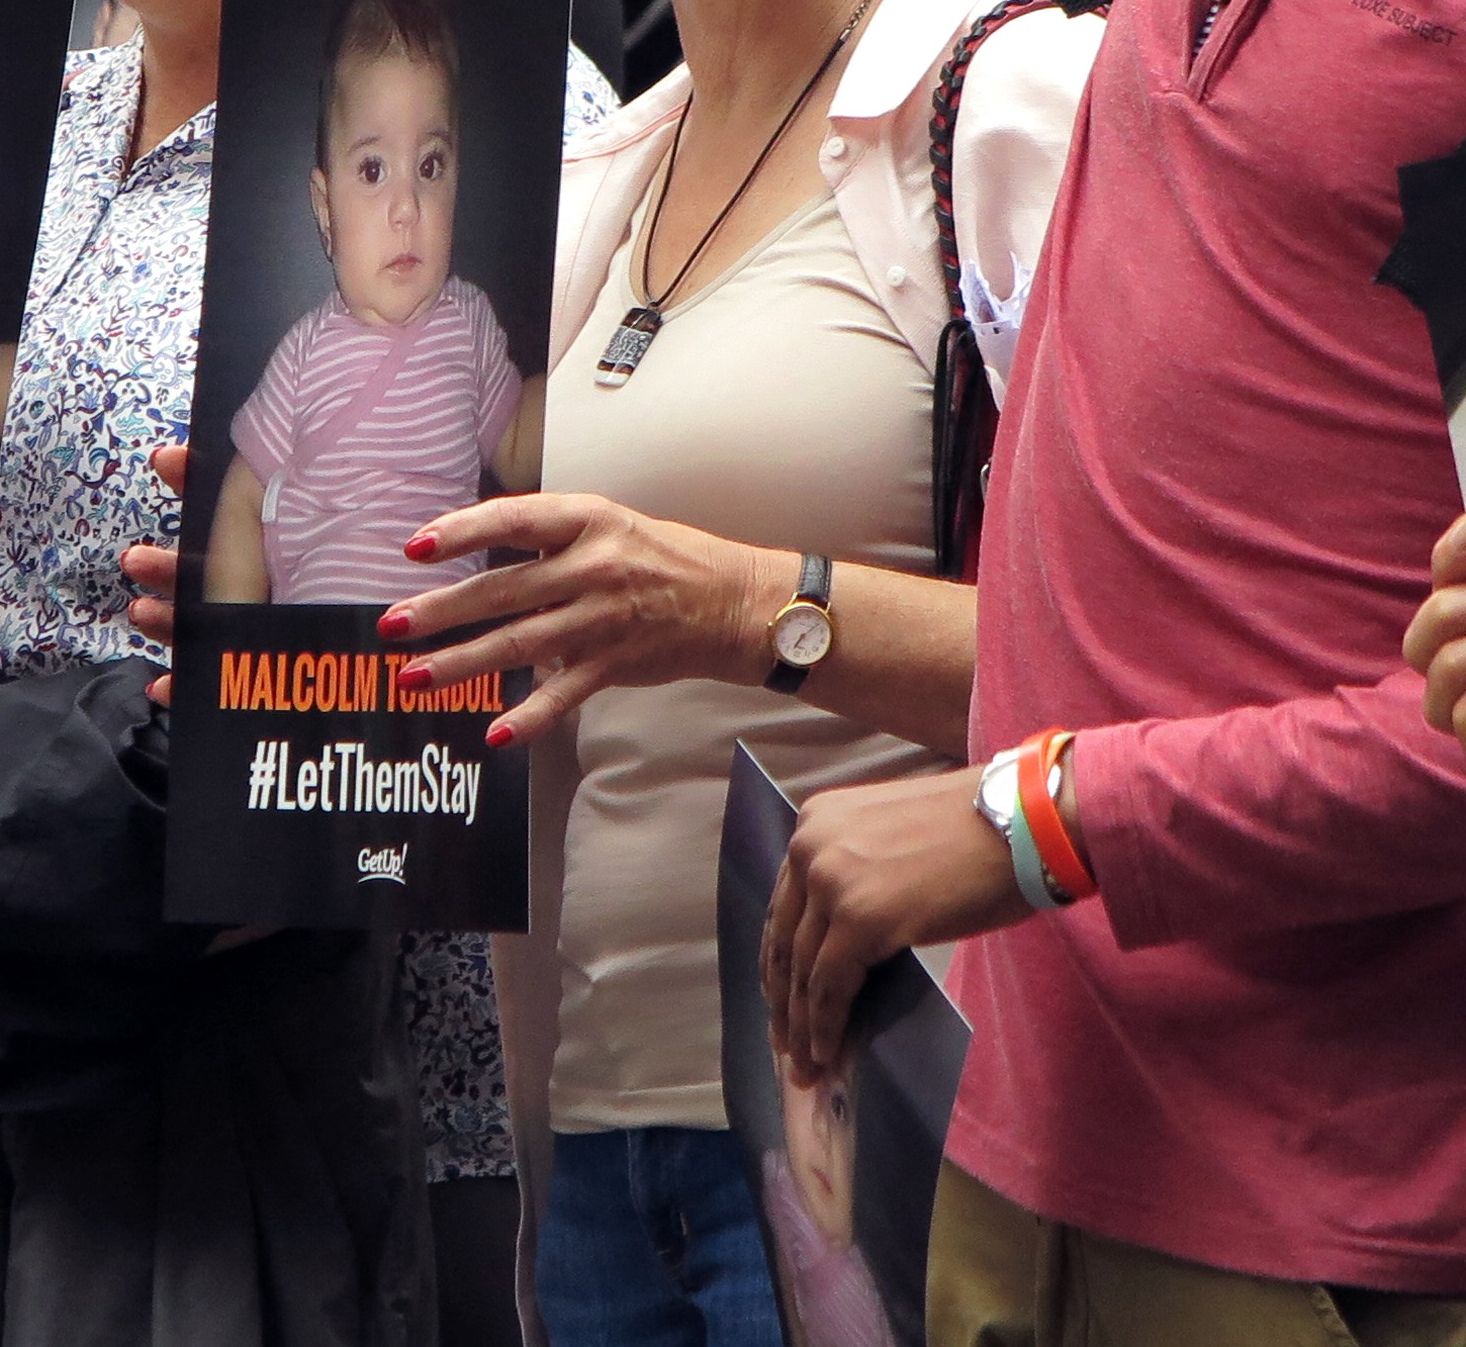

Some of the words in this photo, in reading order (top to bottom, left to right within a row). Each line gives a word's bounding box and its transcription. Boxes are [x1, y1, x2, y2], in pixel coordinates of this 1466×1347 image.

[219, 651, 378, 712] MALCOLM
[247, 739, 481, 826] #LetThemStay
[358, 842, 409, 876] GetUp!
